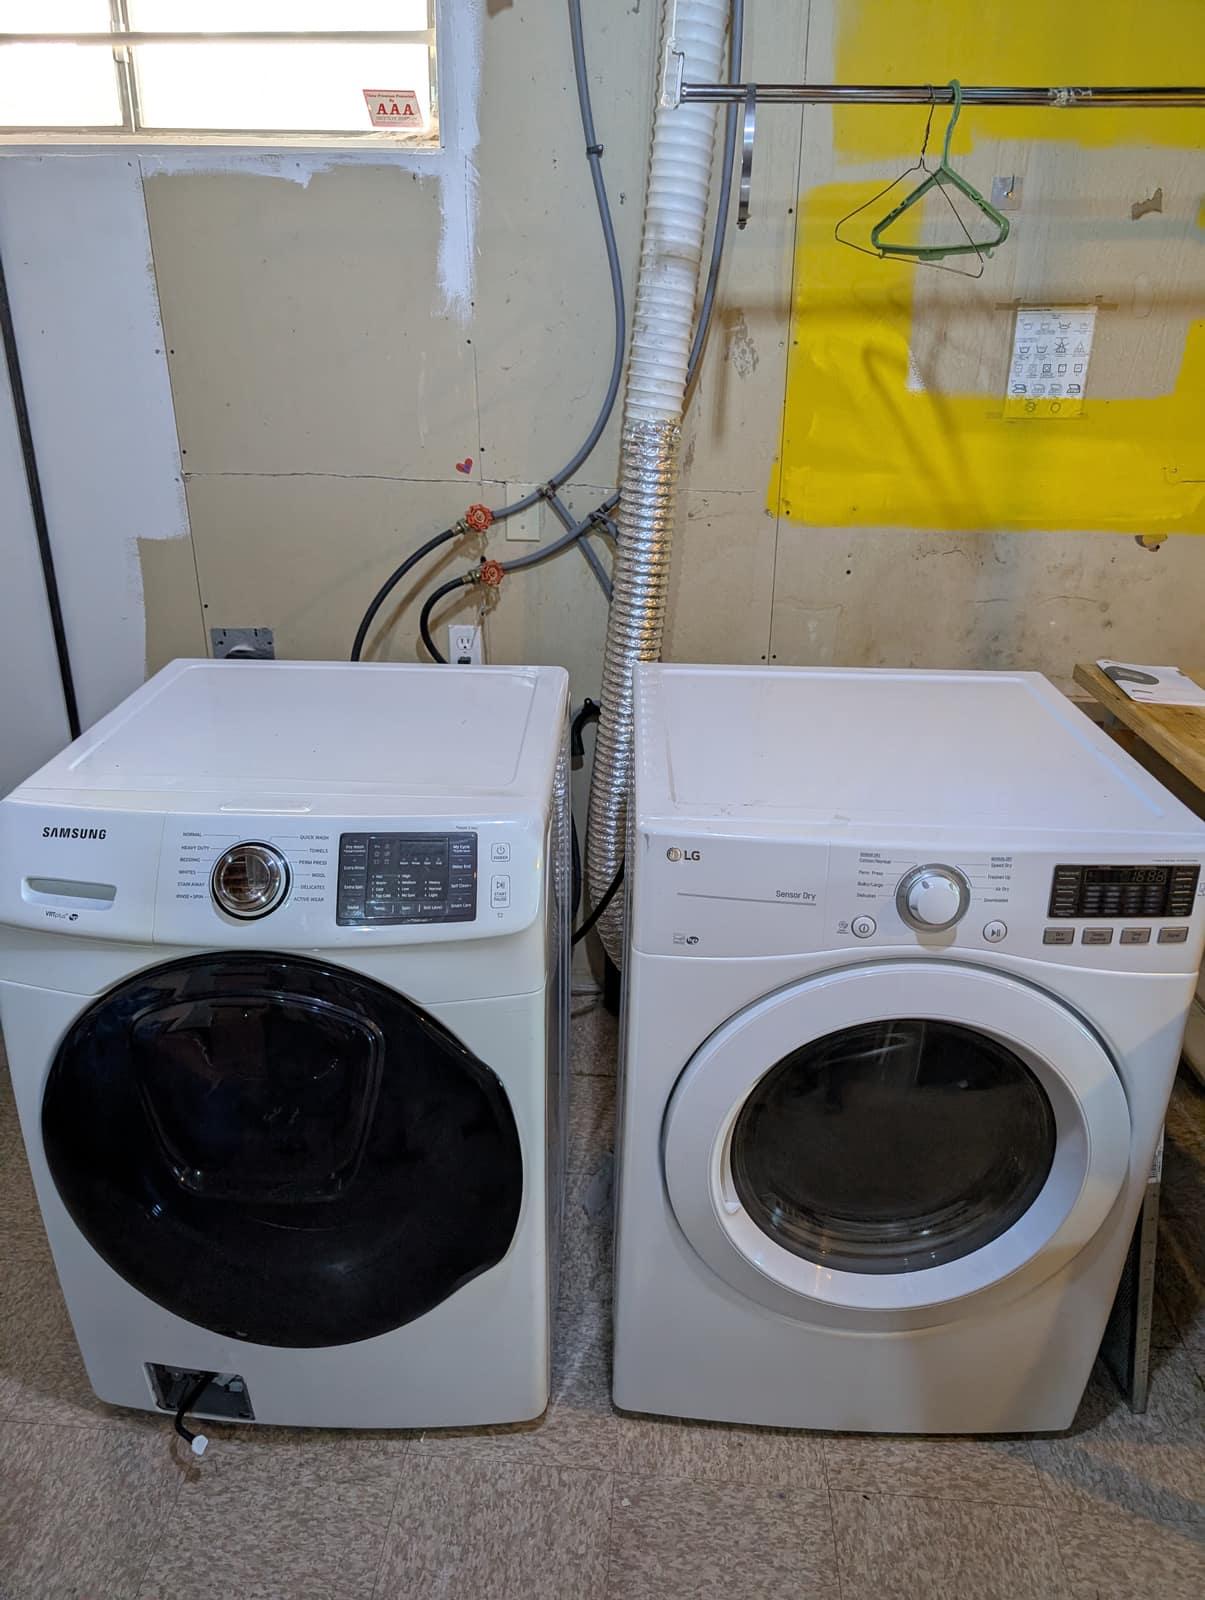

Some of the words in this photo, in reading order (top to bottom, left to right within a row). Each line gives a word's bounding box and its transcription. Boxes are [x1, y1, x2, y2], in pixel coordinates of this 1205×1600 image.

[376, 103, 415, 116] AAA
[42, 826, 107, 840] SAMSUNG
[683, 850, 700, 861] LG
[775, 890, 801, 899] Sensor
[802, 891, 816, 901] Dry
